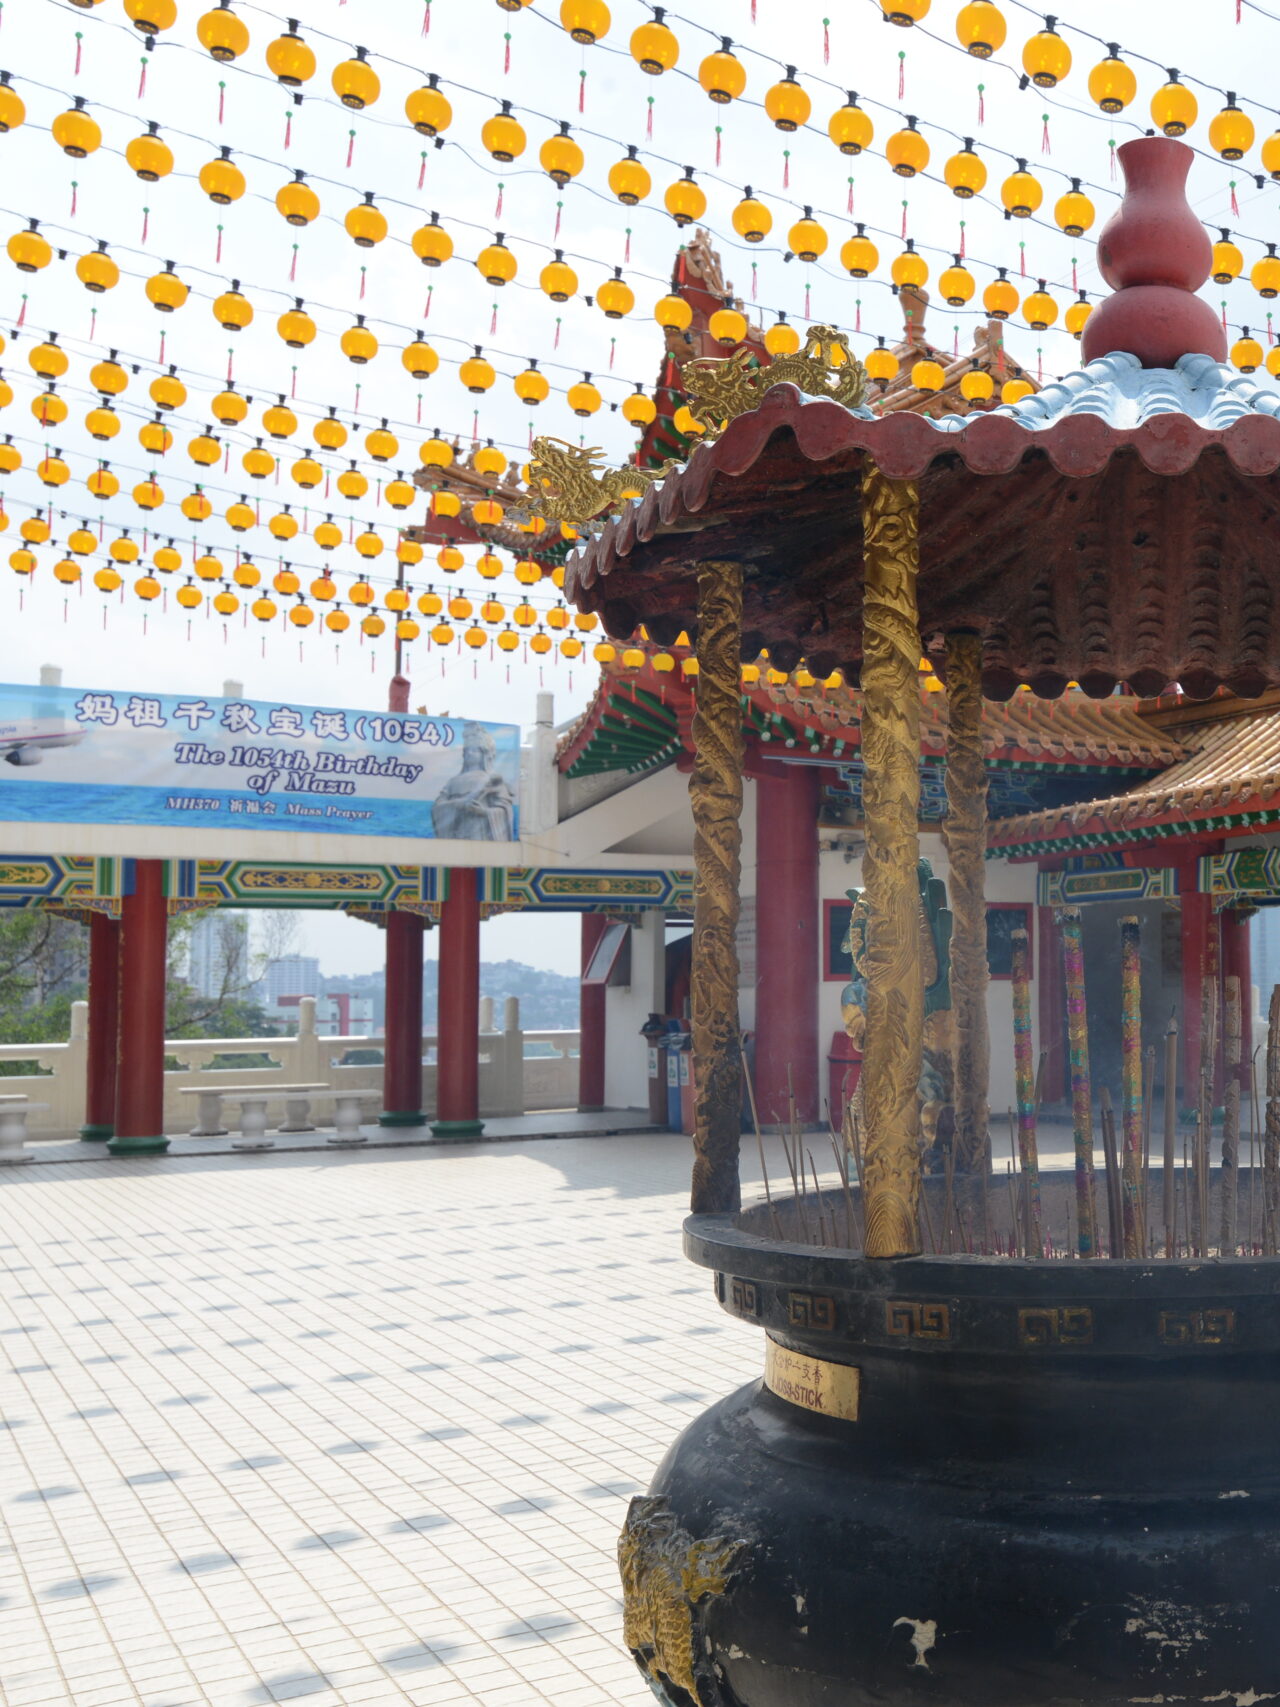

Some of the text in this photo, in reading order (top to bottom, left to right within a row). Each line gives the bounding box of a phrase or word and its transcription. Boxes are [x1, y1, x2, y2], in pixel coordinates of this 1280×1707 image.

[175, 743, 423, 783] The 1054th Birthday
[246, 769, 356, 796] of Mazu
[164, 796, 374, 821] MH370 祈福会 Mass Prayer
